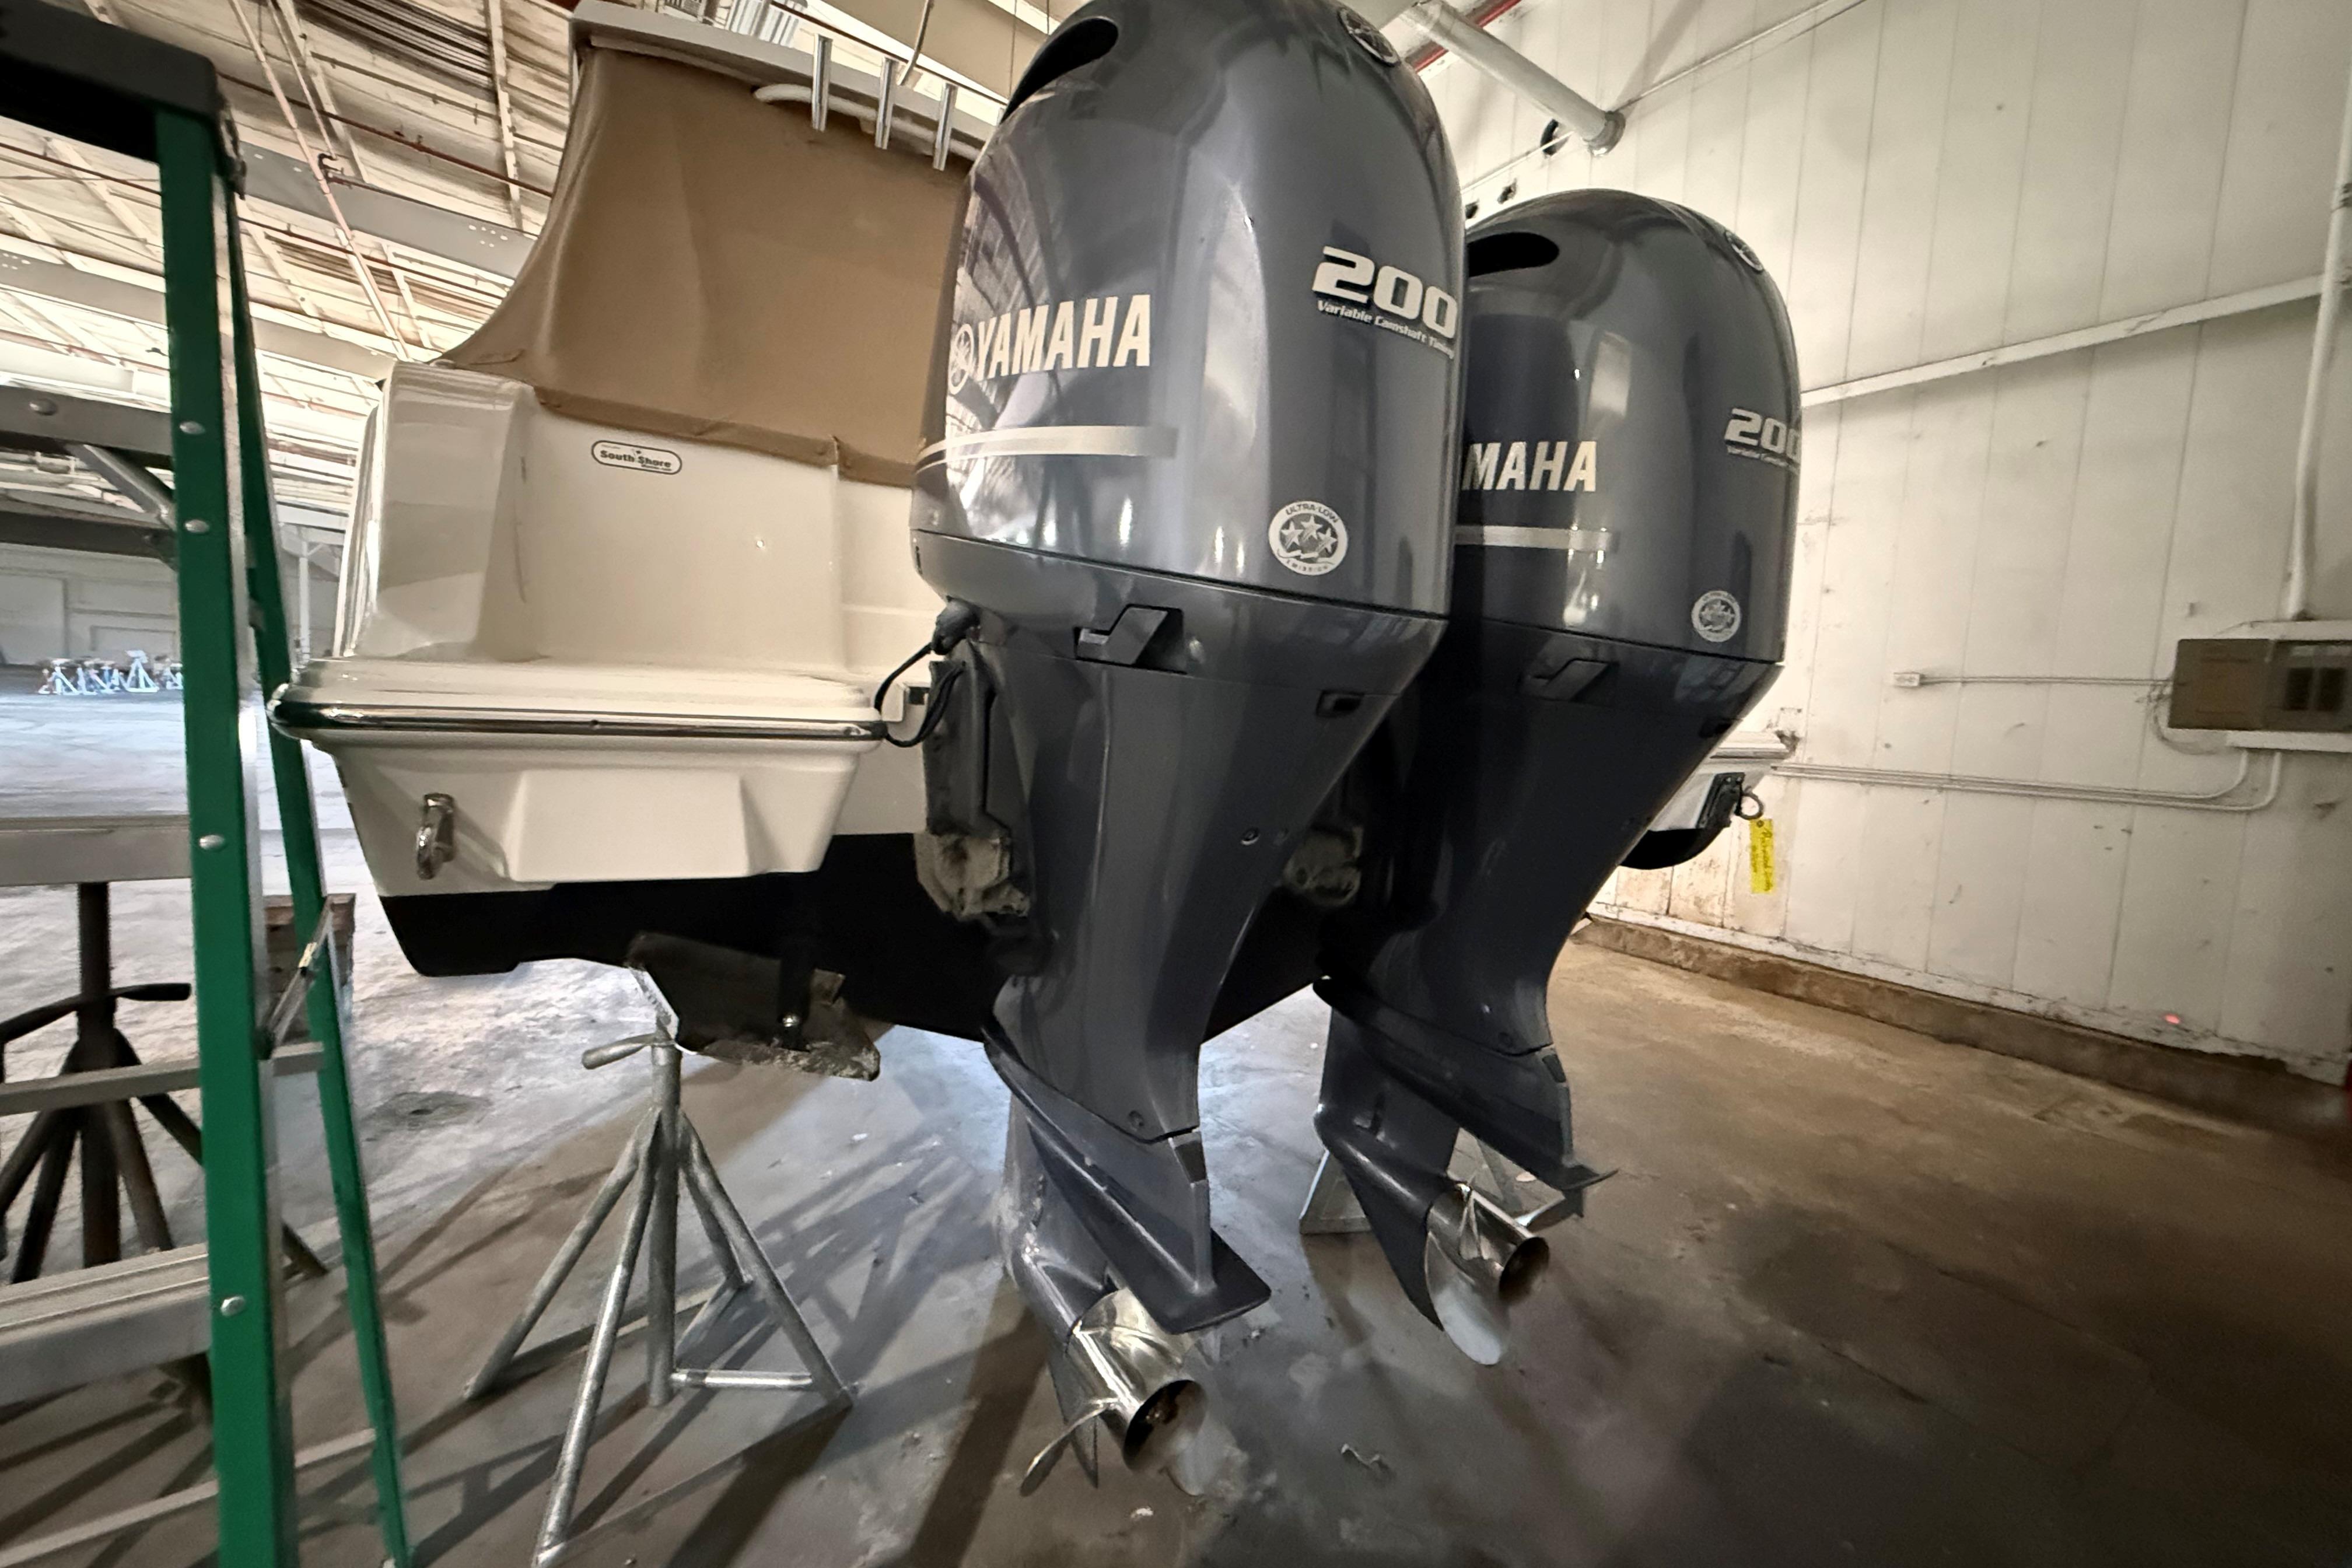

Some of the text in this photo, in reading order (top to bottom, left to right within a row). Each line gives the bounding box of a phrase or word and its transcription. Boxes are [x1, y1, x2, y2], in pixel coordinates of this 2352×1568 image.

[1312, 246, 1457, 338] 200
[1317, 300, 1373, 323] Variable
[1375, 316, 1427, 342] Camshaft
[975, 294, 1150, 381] YAMAHA
[600, 450, 635, 463] South
[638, 456, 672, 468] Shore
